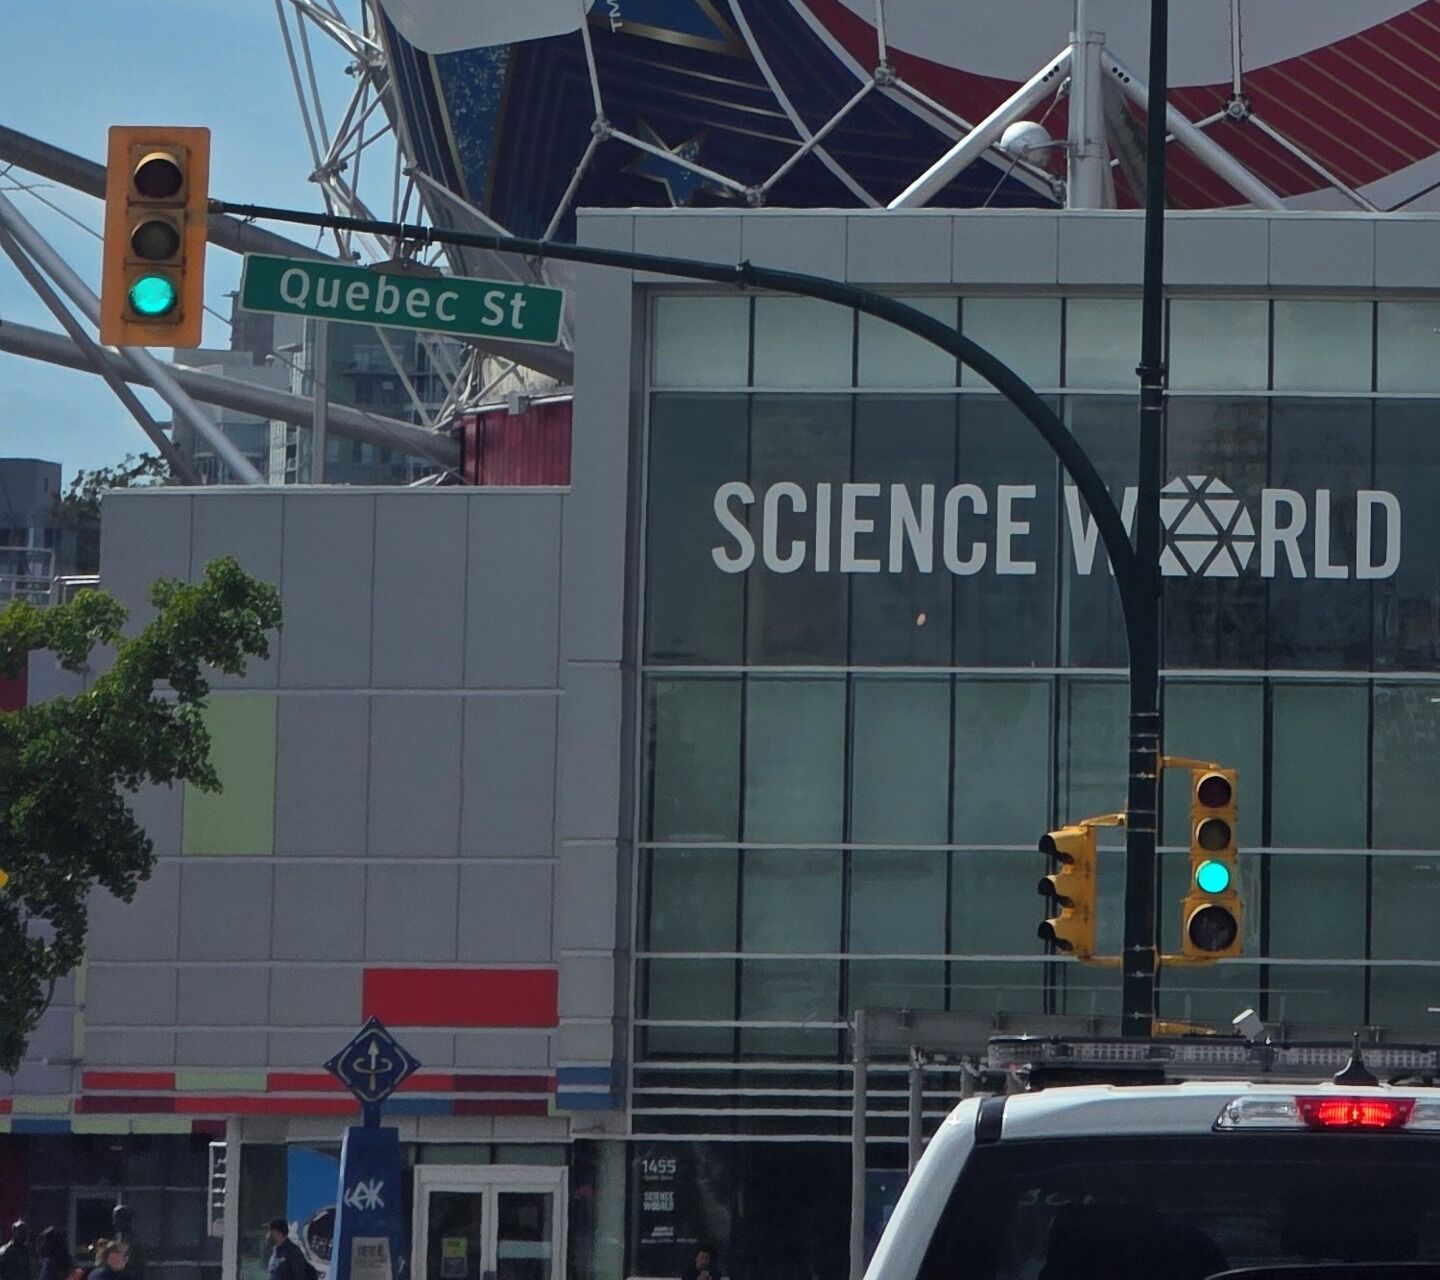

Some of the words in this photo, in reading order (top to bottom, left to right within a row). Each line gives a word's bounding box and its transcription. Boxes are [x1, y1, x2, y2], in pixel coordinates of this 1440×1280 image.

[280, 268, 459, 322] Quebec
[481, 290, 527, 330] St
[711, 481, 1037, 576] SCIENCE
[641, 1159, 677, 1174] 1455
